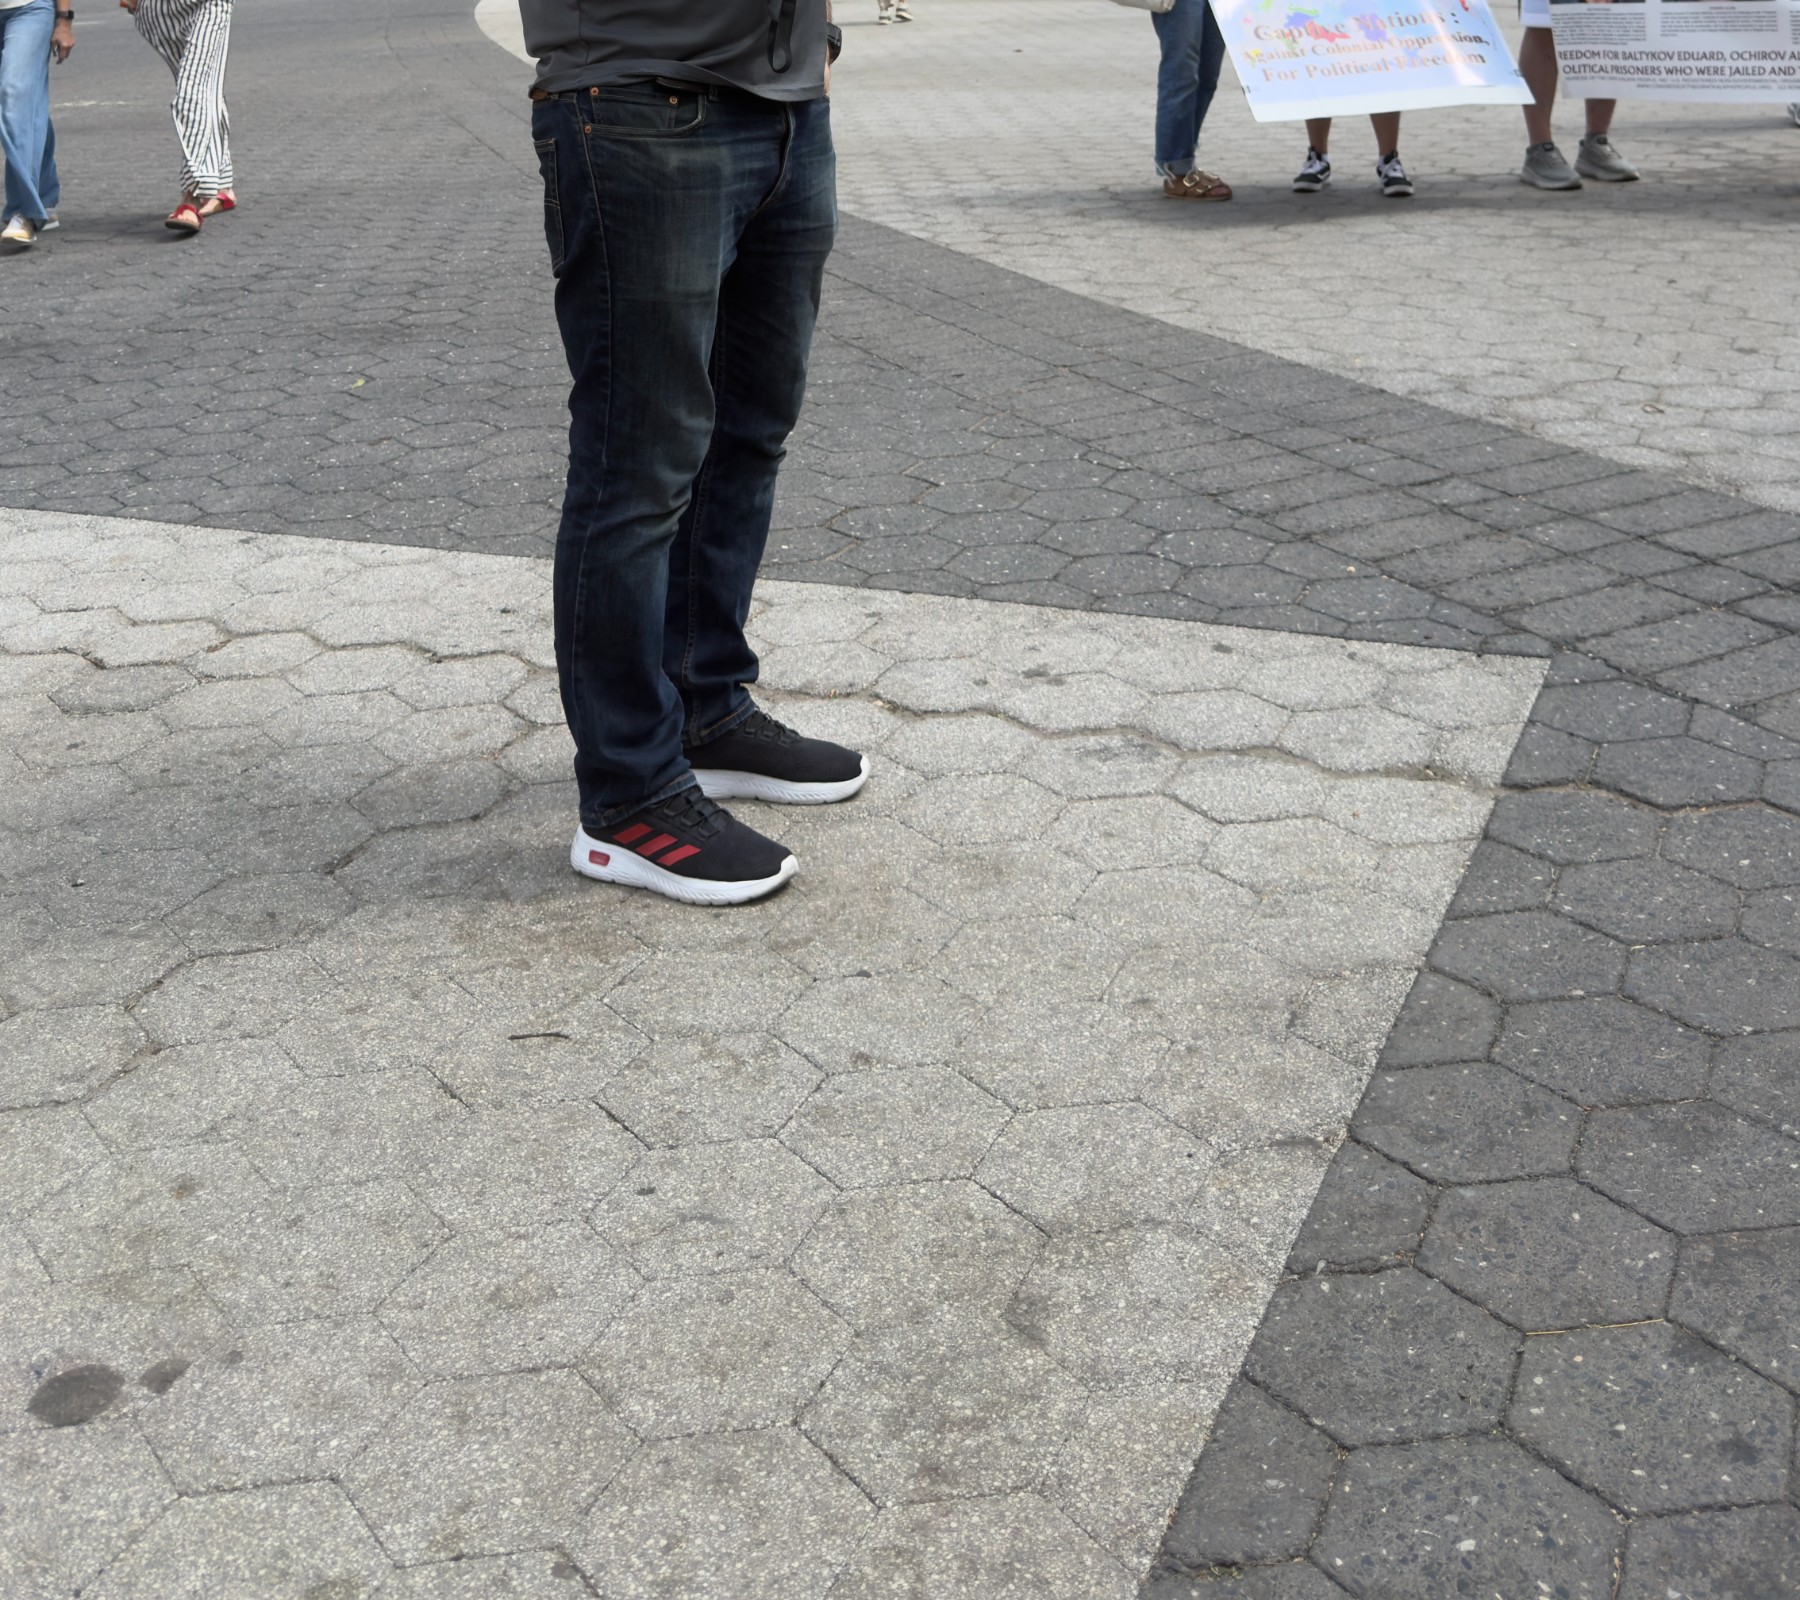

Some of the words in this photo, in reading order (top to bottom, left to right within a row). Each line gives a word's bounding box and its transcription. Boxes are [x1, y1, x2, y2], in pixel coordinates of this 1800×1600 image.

[1254, 22, 1345, 46] Captive
[1311, 39, 1385, 57] Colonial
[1558, 49, 1600, 61] REEDOM
[1602, 49, 1619, 60] FOR
[1621, 50, 1675, 61] BALTYKOV
[1677, 50, 1727, 63] EDUARD,
[1729, 50, 1786, 61] OCHIROV
[1262, 67, 1299, 82] For
[1305, 58, 1391, 79] Political
[1562, 63, 1609, 75] OLITICAL
[1610, 64, 1662, 76] PRISONERS
[1663, 65, 1693, 76] WHO
[1695, 65, 1727, 76] WERE
[1729, 65, 1767, 77] JAILED
[1768, 65, 1797, 76] AND
